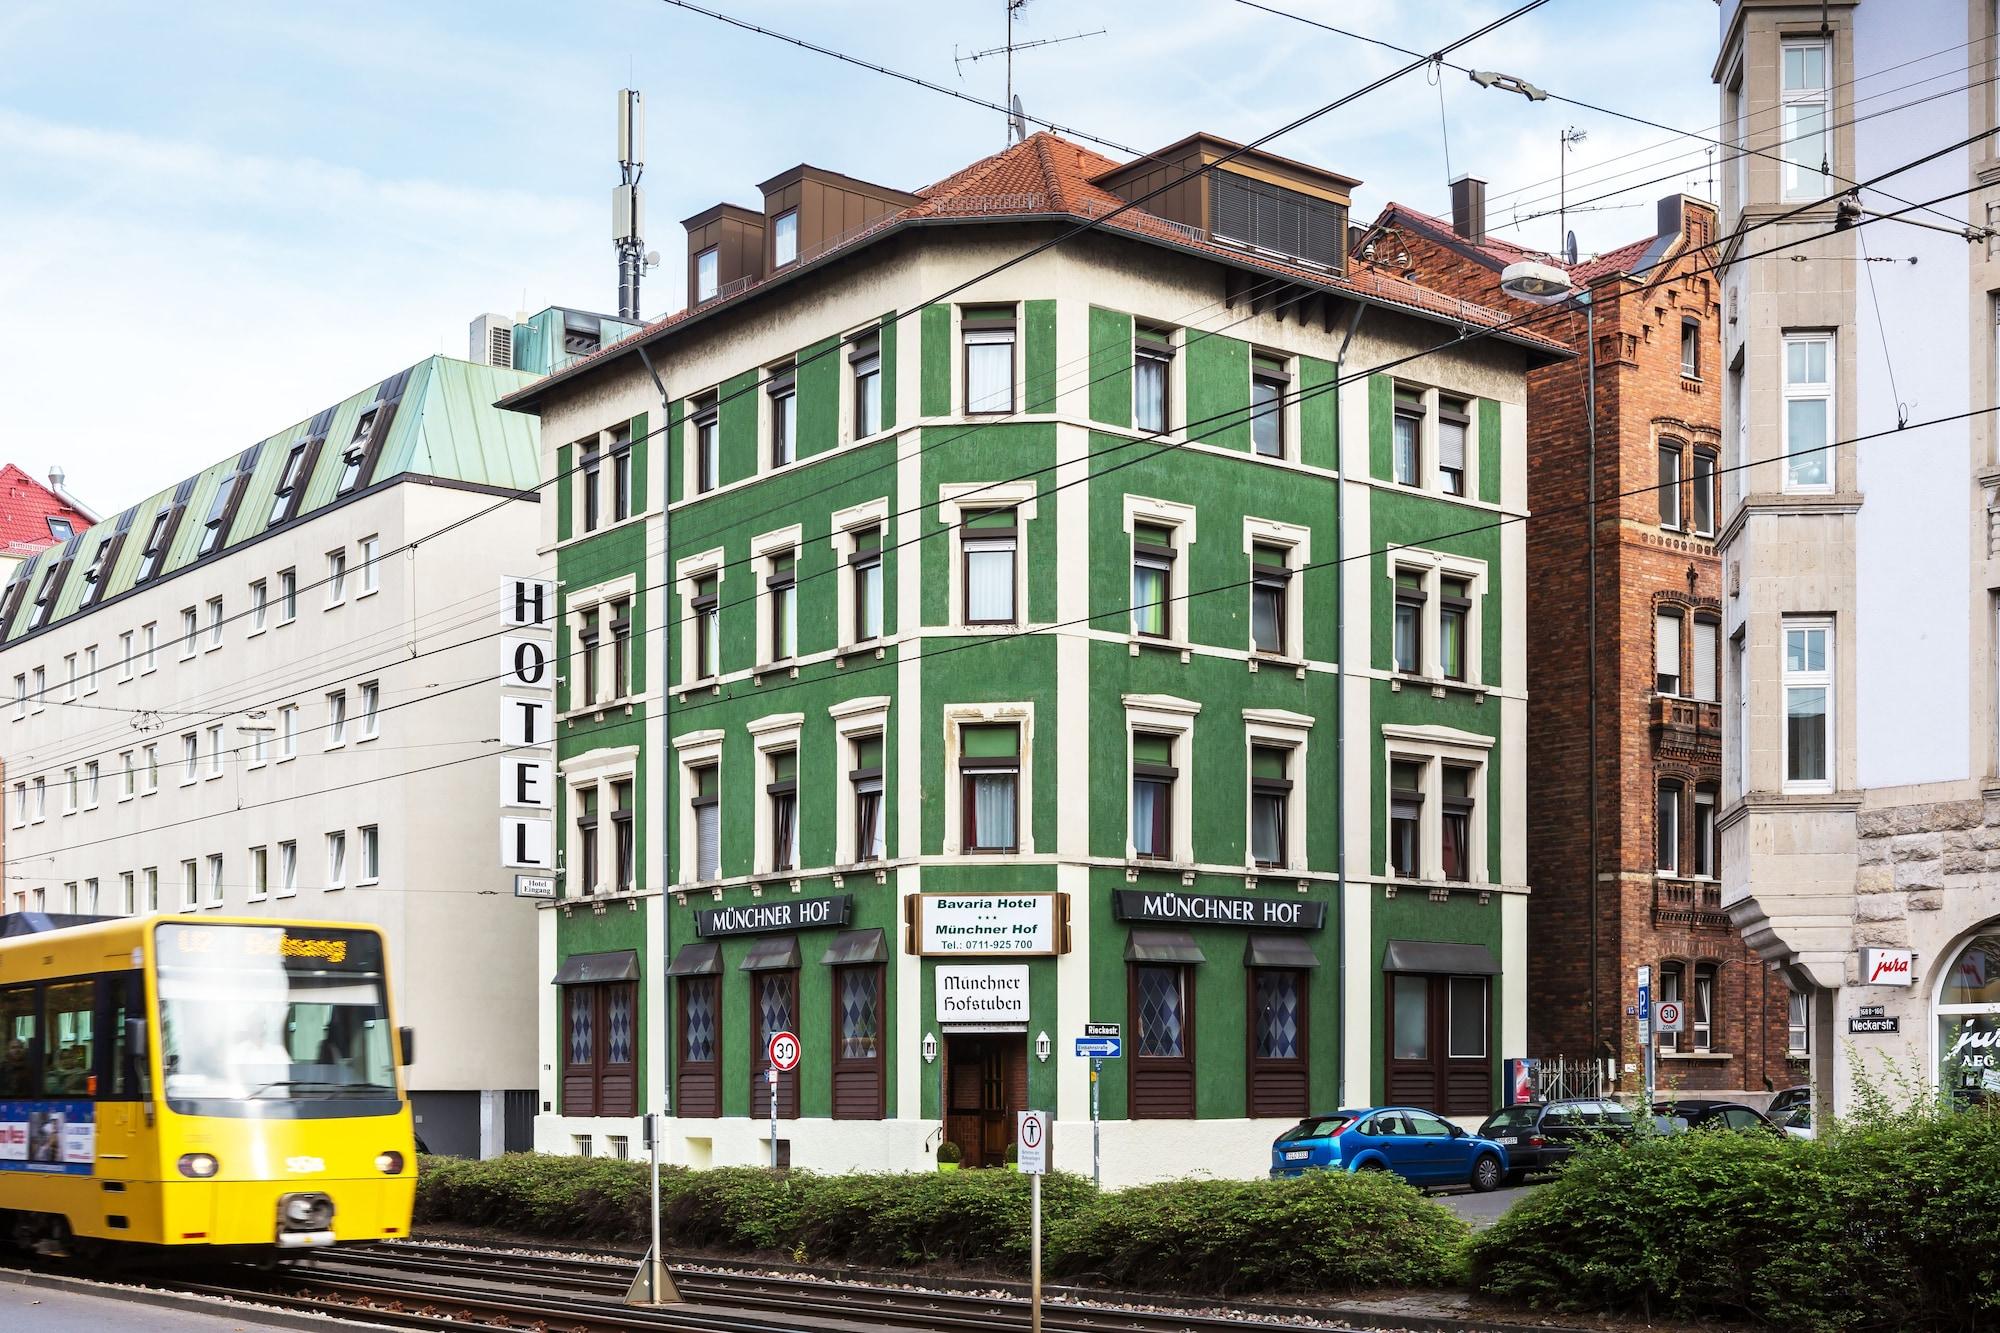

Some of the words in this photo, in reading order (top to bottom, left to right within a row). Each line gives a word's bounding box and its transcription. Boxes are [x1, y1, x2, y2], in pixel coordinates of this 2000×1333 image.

[514, 581, 544, 864] HOTEL
[524, 886, 551, 895] Eingang
[937, 899, 993, 909] Bavaria
[997, 898, 1037, 909] Hotel
[1143, 892, 1255, 921] MÜNCHNER
[1263, 902, 1302, 923] HOF
[713, 905, 792, 931] MÜNCHNER
[799, 901, 831, 923] HOF
[935, 924, 1008, 935] Münchner
[1012, 924, 1038, 934] Hof
[941, 941, 962, 950] Tel.:
[965, 941, 1012, 949] 0711-925
[1015, 940, 1033, 949] 700
[1871, 952, 1908, 982] jura
[944, 975, 1020, 991] Münchner
[944, 995, 1021, 1011] Hofstuben
[1663, 1009, 1675, 1019] 30
[1088, 1025, 1118, 1035] Rieckestr.
[1852, 1020, 1896, 1031] Neckarstr.
[776, 1043, 794, 1059] 30
[1961, 1055, 1995, 1067] AEG
